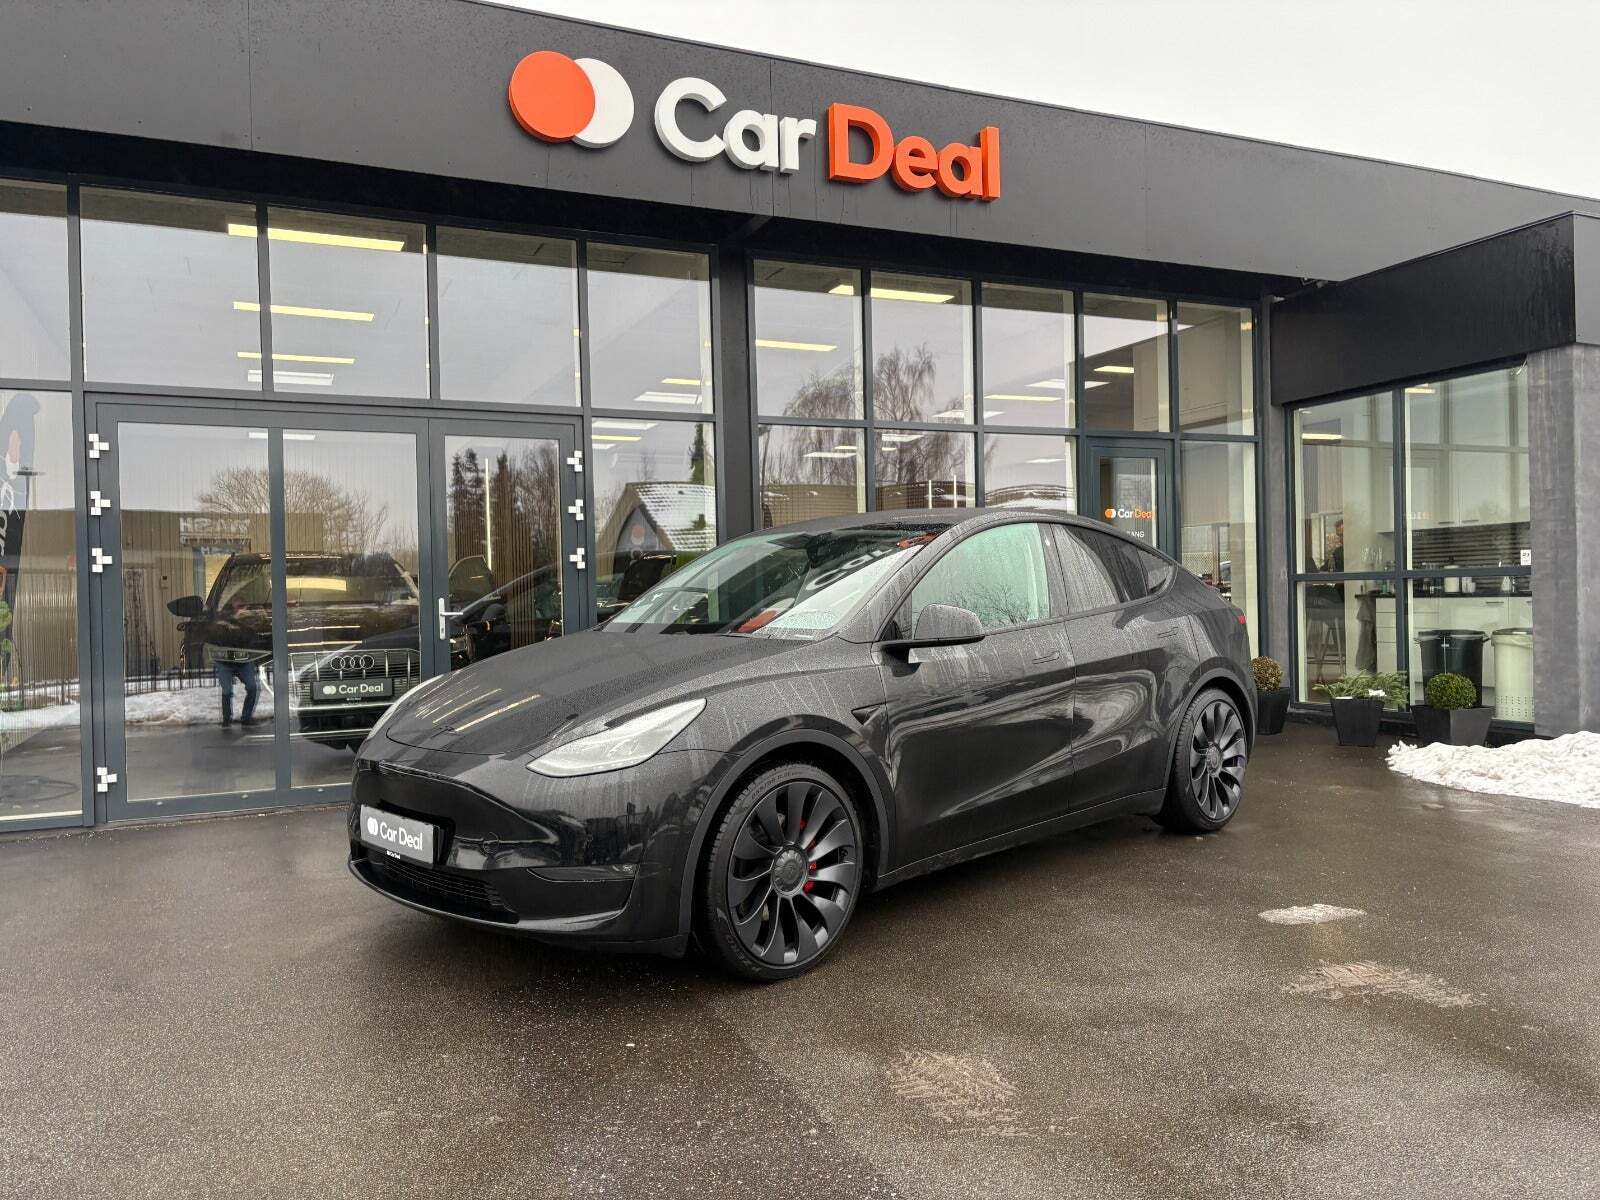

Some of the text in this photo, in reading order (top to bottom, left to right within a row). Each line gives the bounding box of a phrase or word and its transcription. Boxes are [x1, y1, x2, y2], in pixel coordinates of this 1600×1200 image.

[654, 76, 1000, 200] Car Deal
[1117, 508, 1133, 518] Car
[338, 682, 384, 694] Car Deal
[380, 821, 423, 850] Car Deal
